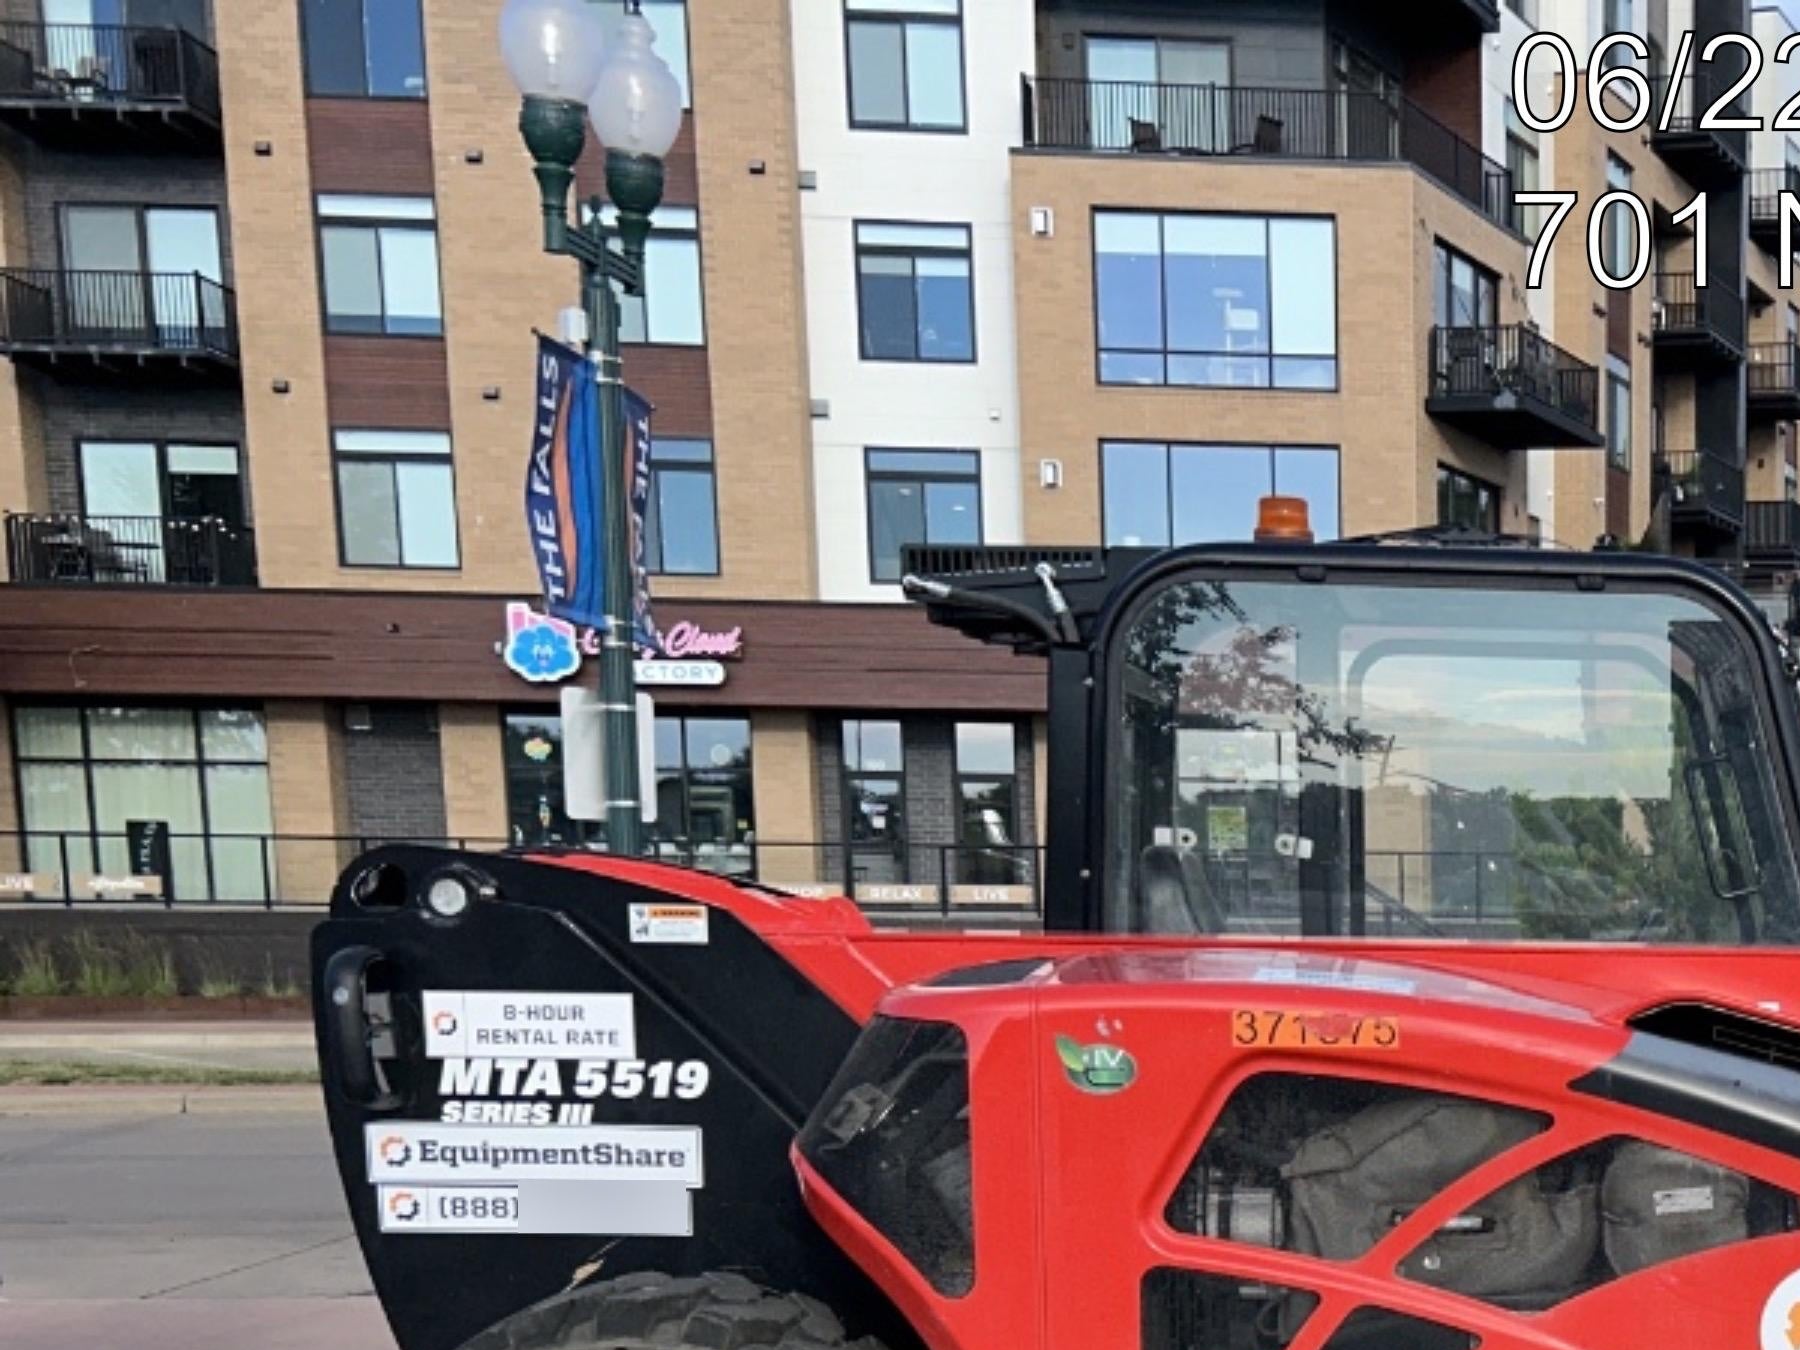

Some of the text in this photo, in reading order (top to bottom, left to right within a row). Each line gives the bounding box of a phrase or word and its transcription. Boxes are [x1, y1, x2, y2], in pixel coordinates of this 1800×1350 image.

[533, 354, 566, 604] THE FALLS
[640, 665, 719, 680] CTORY
[476, 1029, 620, 1047] RENTAL RATE
[438, 1058, 710, 1099] MTA 5519
[440, 1101, 594, 1125] SERIES III
[418, 1138, 686, 1170] EquipmentShare
